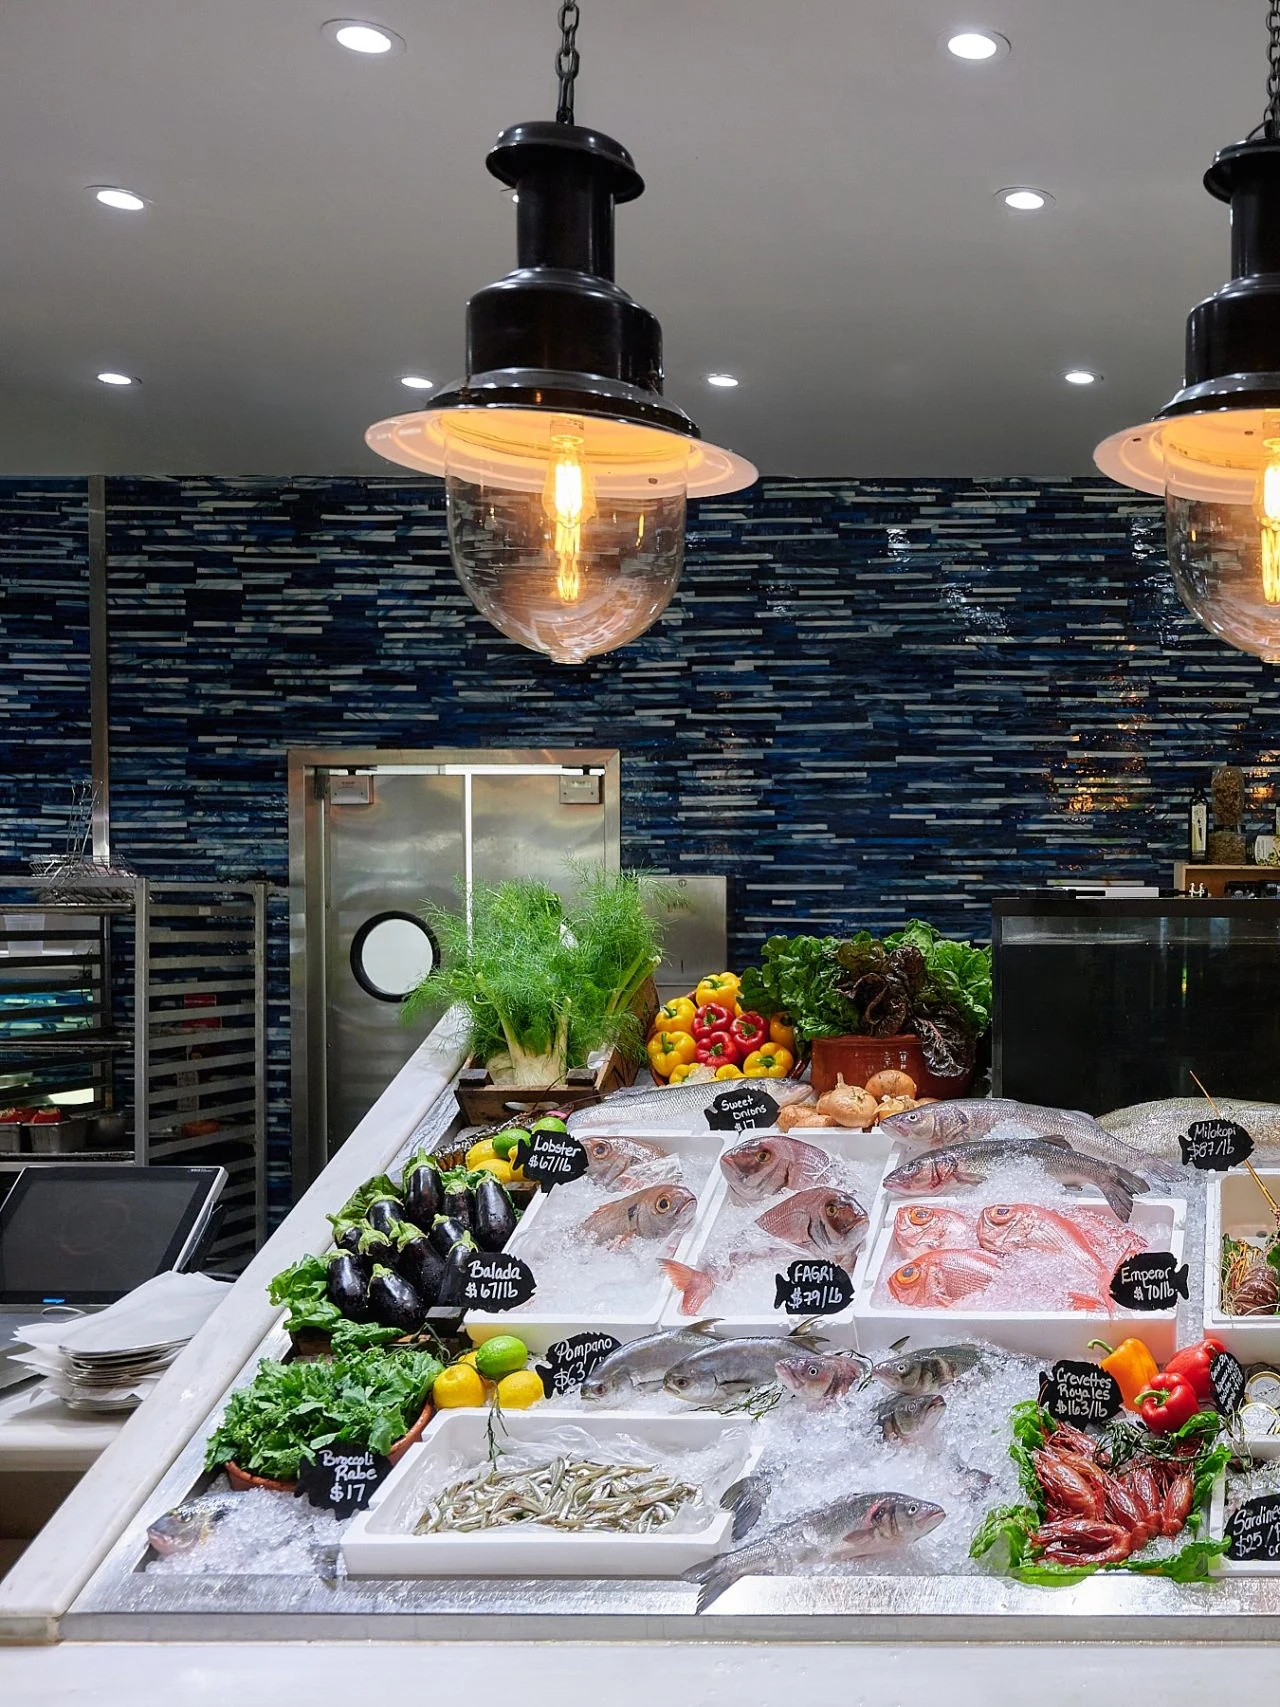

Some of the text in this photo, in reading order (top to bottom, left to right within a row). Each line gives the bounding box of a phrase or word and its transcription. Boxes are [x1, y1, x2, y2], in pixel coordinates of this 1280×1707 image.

[721, 1095, 754, 1111] Sweet
[734, 1119, 756, 1132] $17
[533, 1135, 582, 1157] Lobster
[1187, 1138, 1235, 1160] $87/lb
[528, 1154, 572, 1173] $67/lb
[467, 1260, 522, 1280] Balada
[794, 1264, 833, 1283] FAGRI
[1121, 1266, 1172, 1288] Emperor
[464, 1281, 519, 1300] $67/lb
[554, 1338, 613, 1364] Pompano
[1056, 1367, 1112, 1389] Crevettes
[1057, 1383, 1111, 1401] Royales
[1054, 1400, 1108, 1419] $163/lb
[319, 1449, 374, 1467] Broccoli
[334, 1464, 378, 1481] Rabe
[329, 1482, 366, 1502] $17
